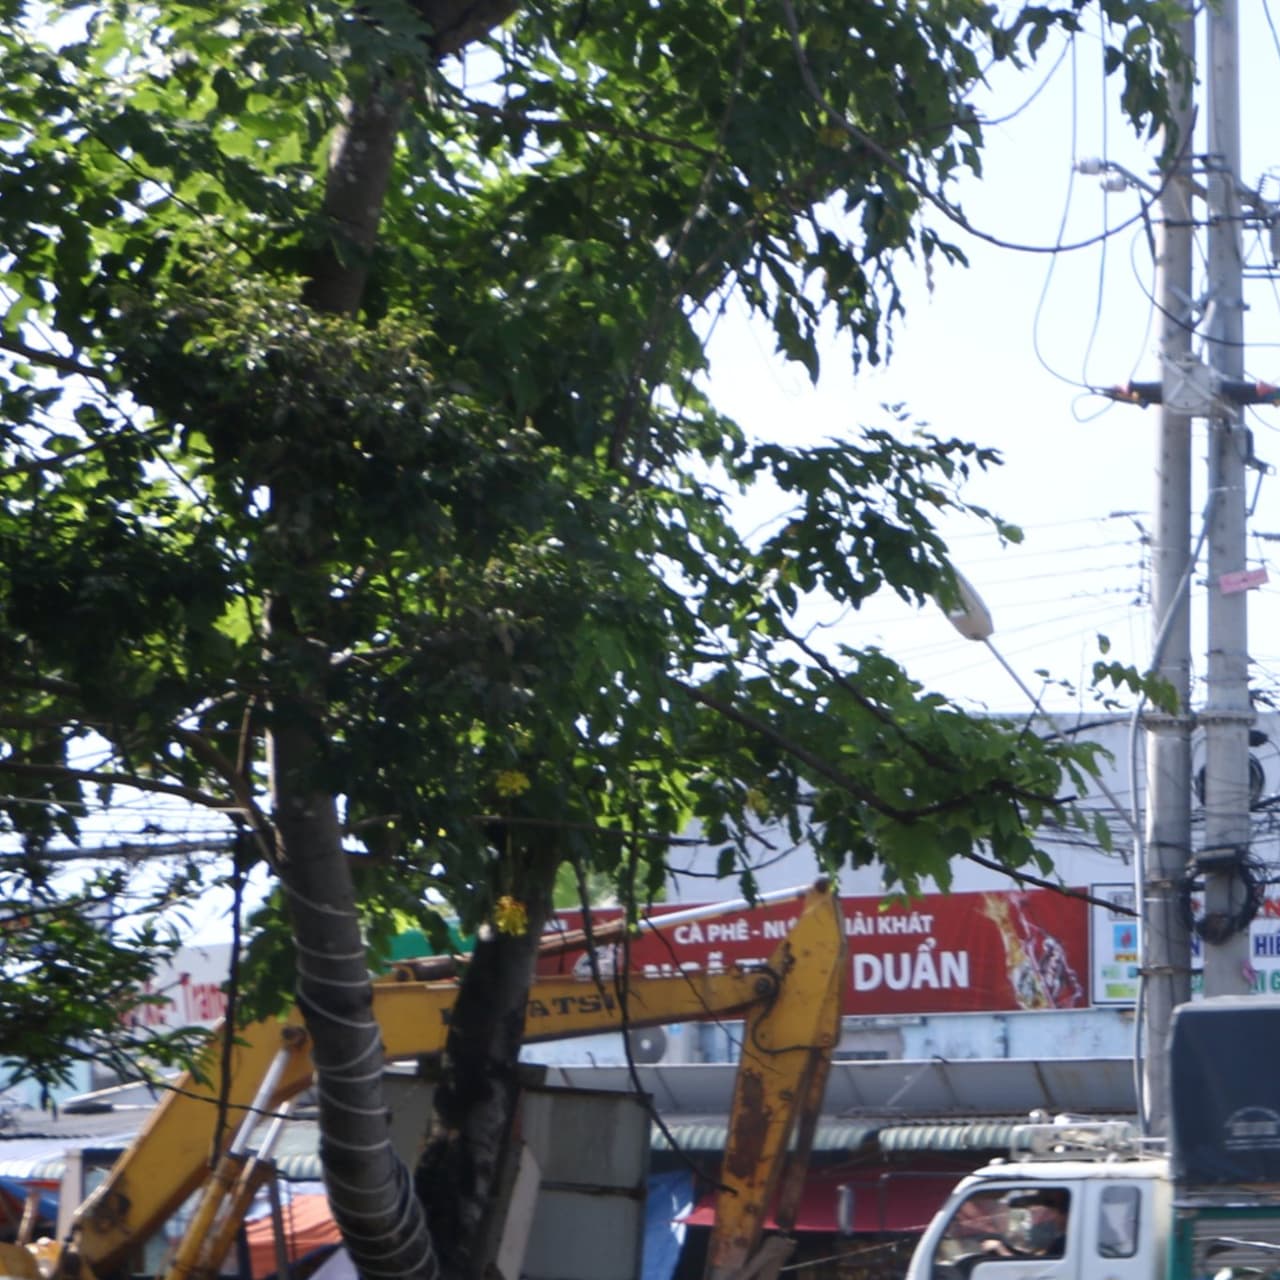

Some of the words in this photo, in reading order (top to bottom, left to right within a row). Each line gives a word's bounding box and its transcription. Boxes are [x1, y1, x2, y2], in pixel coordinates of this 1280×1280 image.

[673, 920, 705, 944] CÀ
[707, 918, 750, 942] PHÊ
[878, 912, 934, 935] KHÁT
[853, 938, 969, 991] DUẨN
